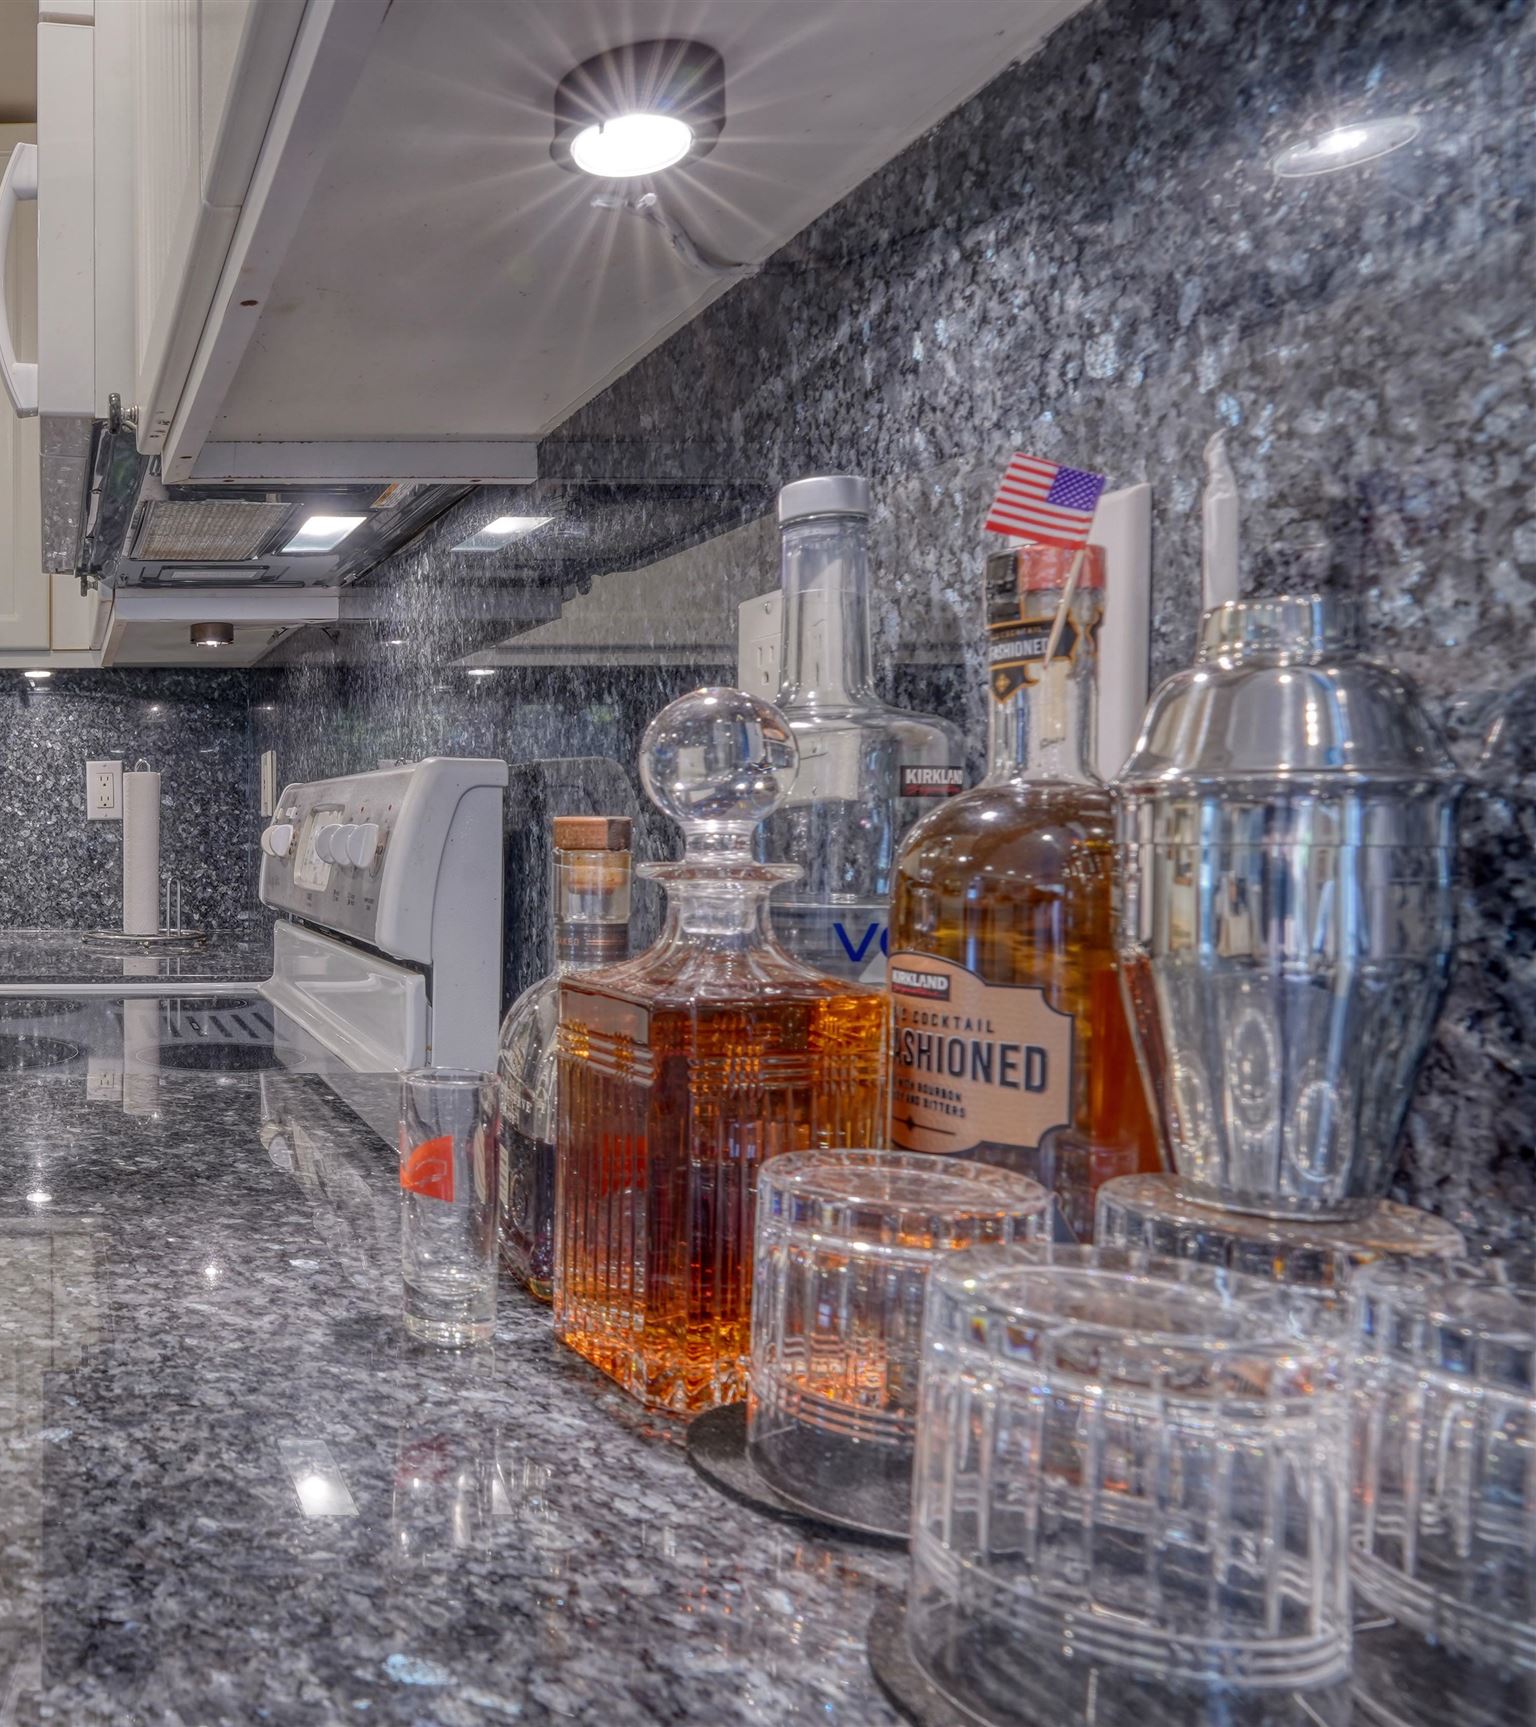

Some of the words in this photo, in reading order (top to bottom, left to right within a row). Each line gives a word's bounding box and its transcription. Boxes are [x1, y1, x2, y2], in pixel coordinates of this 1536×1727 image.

[892, 968, 948, 991] KIRKLAND
[913, 1010, 995, 1034] COCKTAIL
[917, 1083, 962, 1102] BOURBON
[923, 1098, 966, 1118] BITTERS
